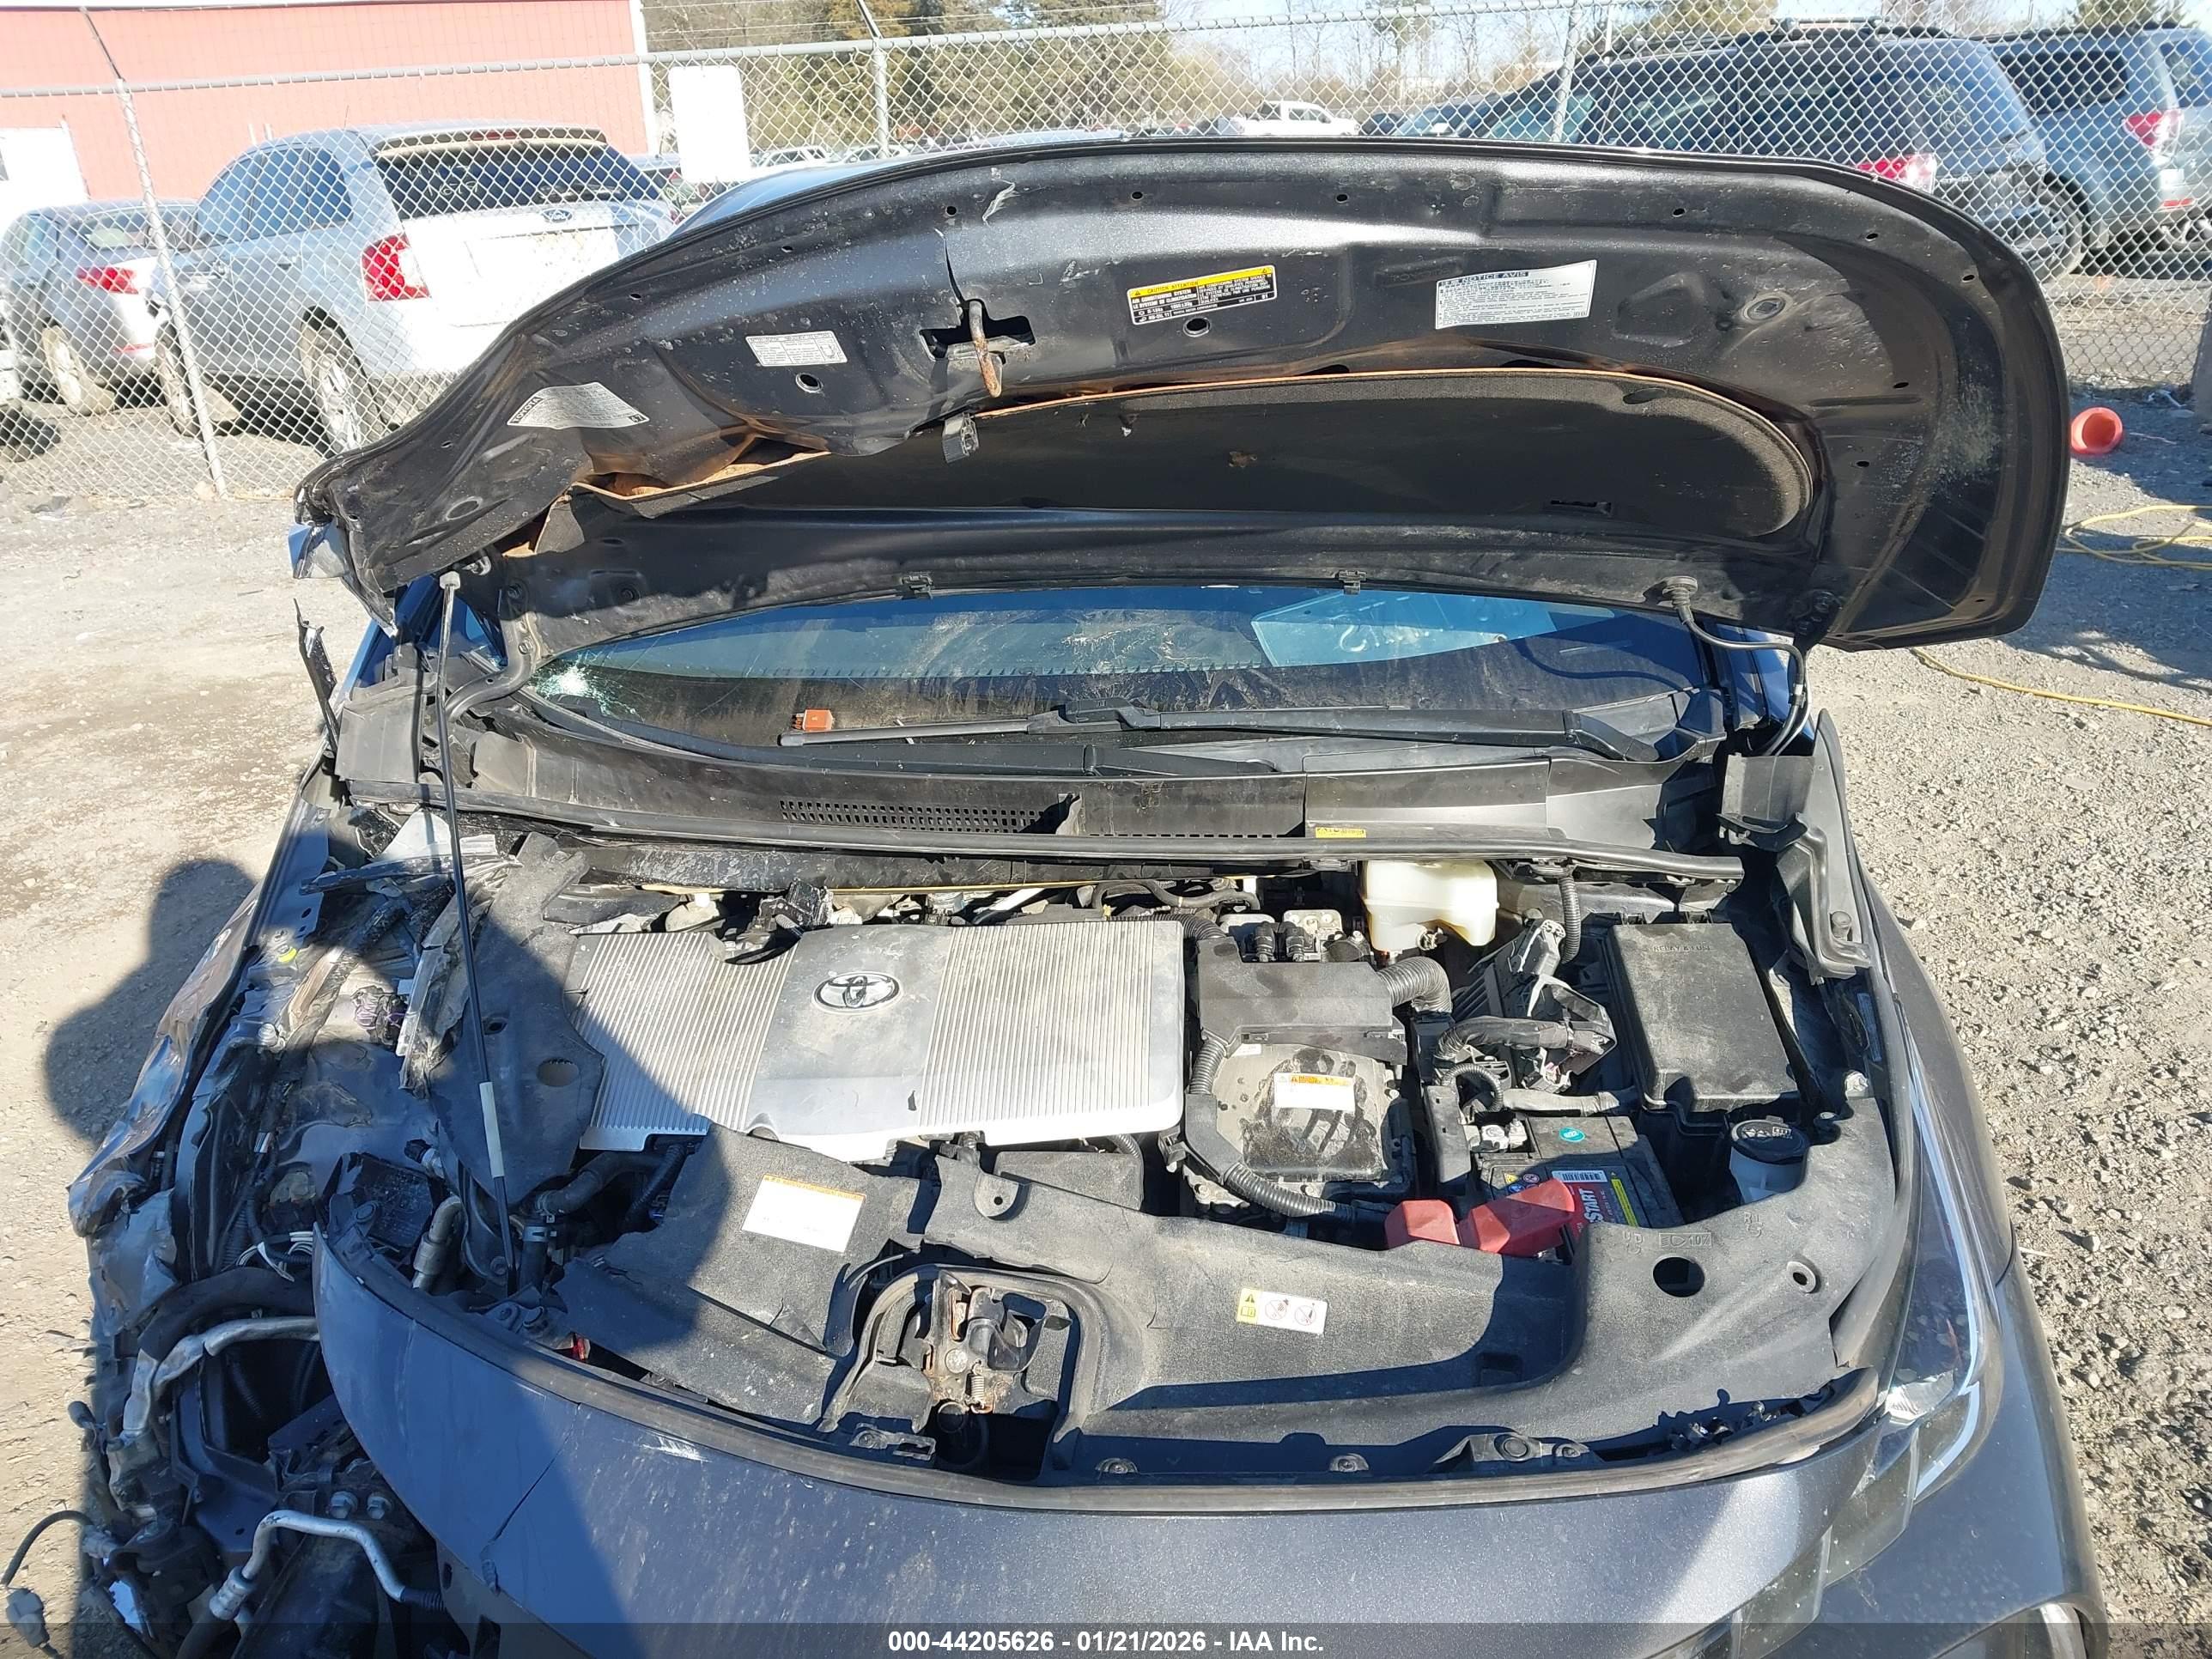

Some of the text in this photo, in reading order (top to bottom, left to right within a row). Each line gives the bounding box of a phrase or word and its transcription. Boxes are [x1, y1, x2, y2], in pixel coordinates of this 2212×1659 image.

[1462, 273, 1498, 283] NOTICE
[512, 397, 543, 422] TOYOTA
[1579, 1188, 1603, 1221] START
